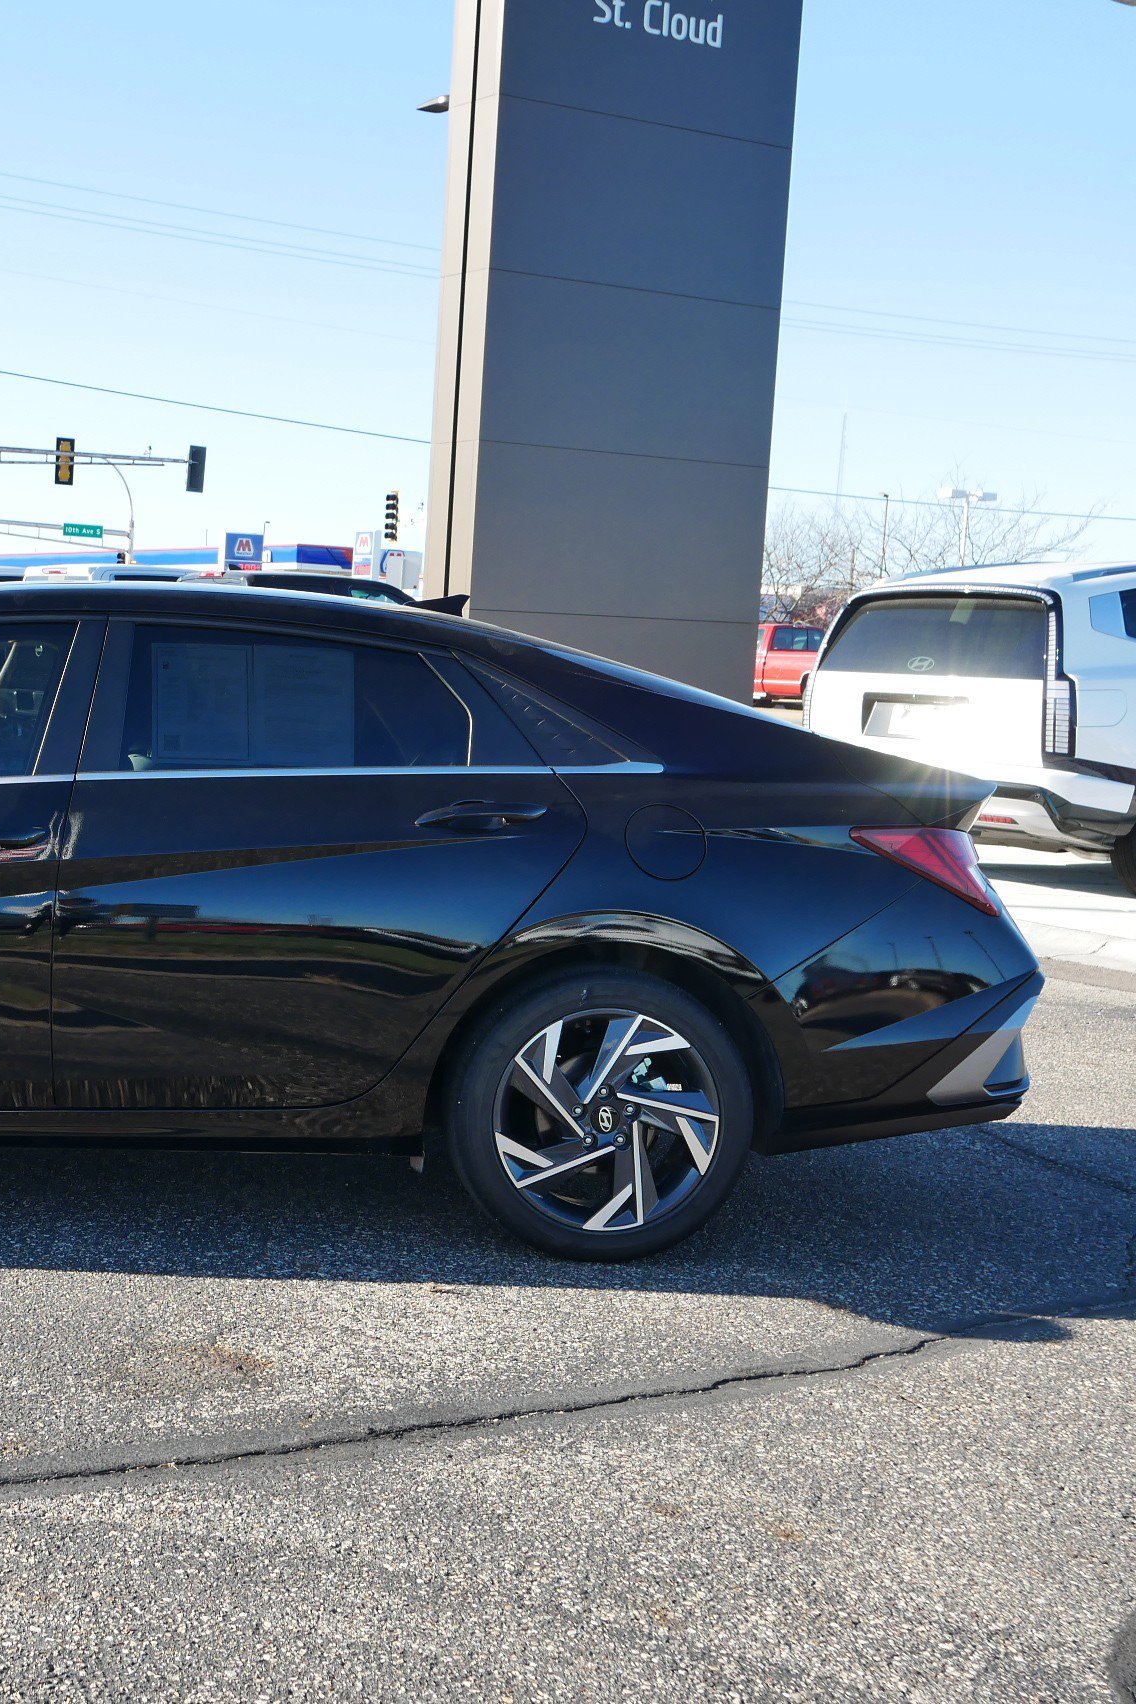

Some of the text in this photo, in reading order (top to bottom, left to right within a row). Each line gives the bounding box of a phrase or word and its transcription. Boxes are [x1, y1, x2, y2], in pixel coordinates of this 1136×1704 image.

[592, 0, 724, 49] St. Cloud
[82, 527, 94, 535] Ave
